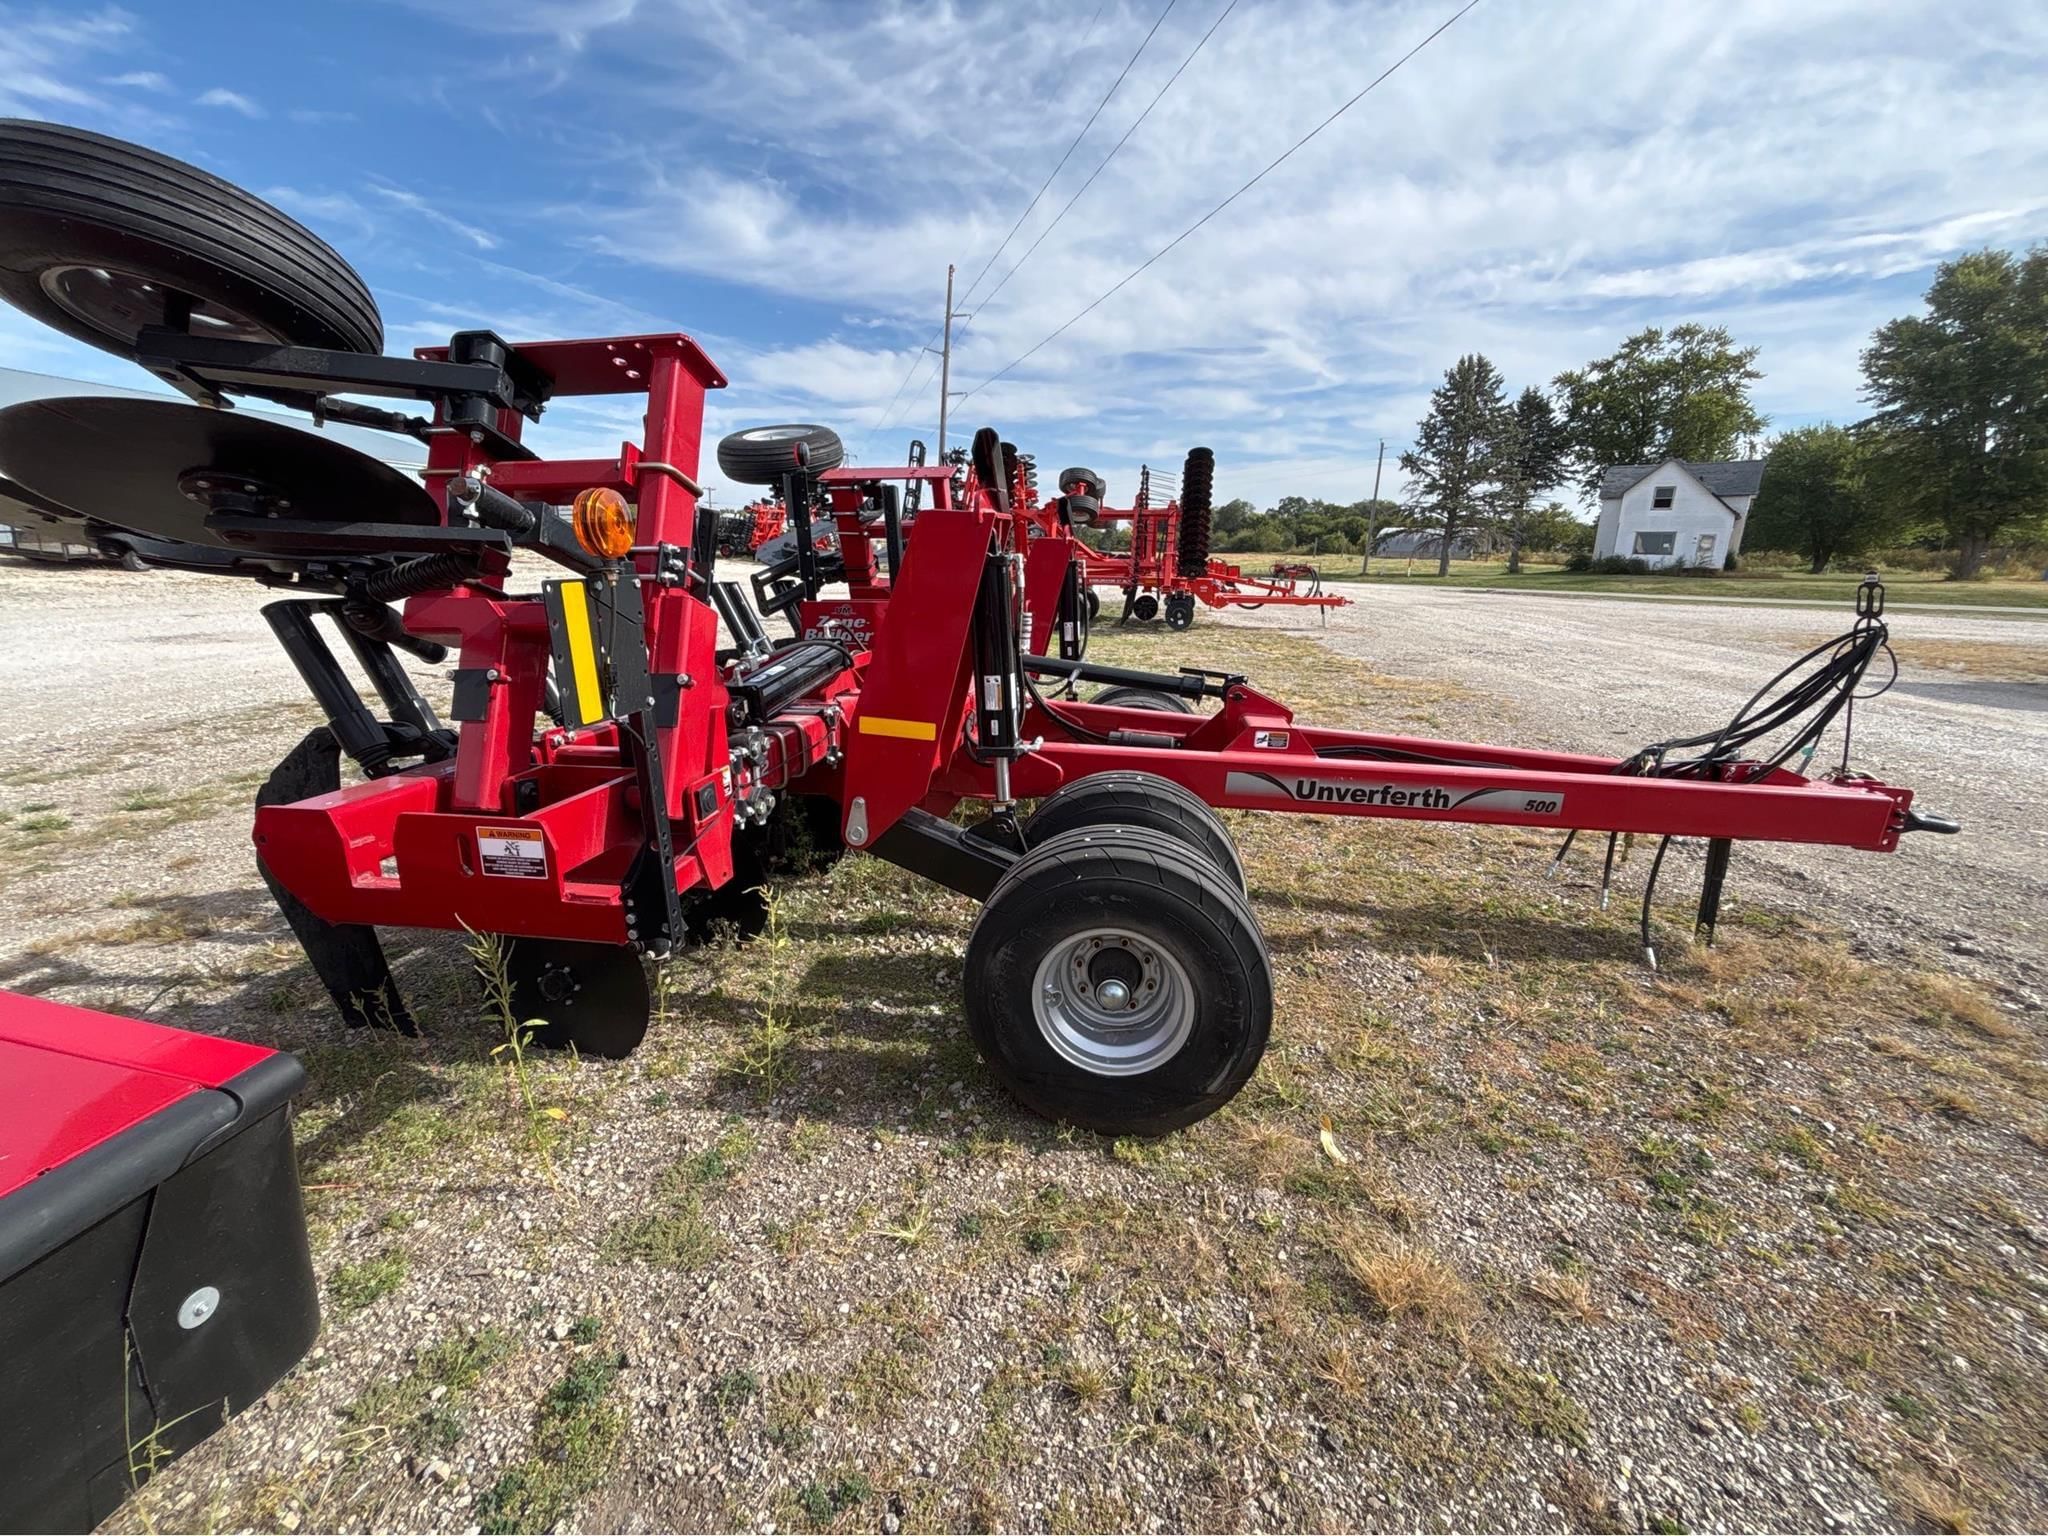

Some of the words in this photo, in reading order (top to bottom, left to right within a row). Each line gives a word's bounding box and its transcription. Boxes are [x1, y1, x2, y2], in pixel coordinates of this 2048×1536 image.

[1295, 779, 1451, 809] Unverferth
[1524, 799, 1557, 814] 500
[495, 830, 531, 839] WARNING
